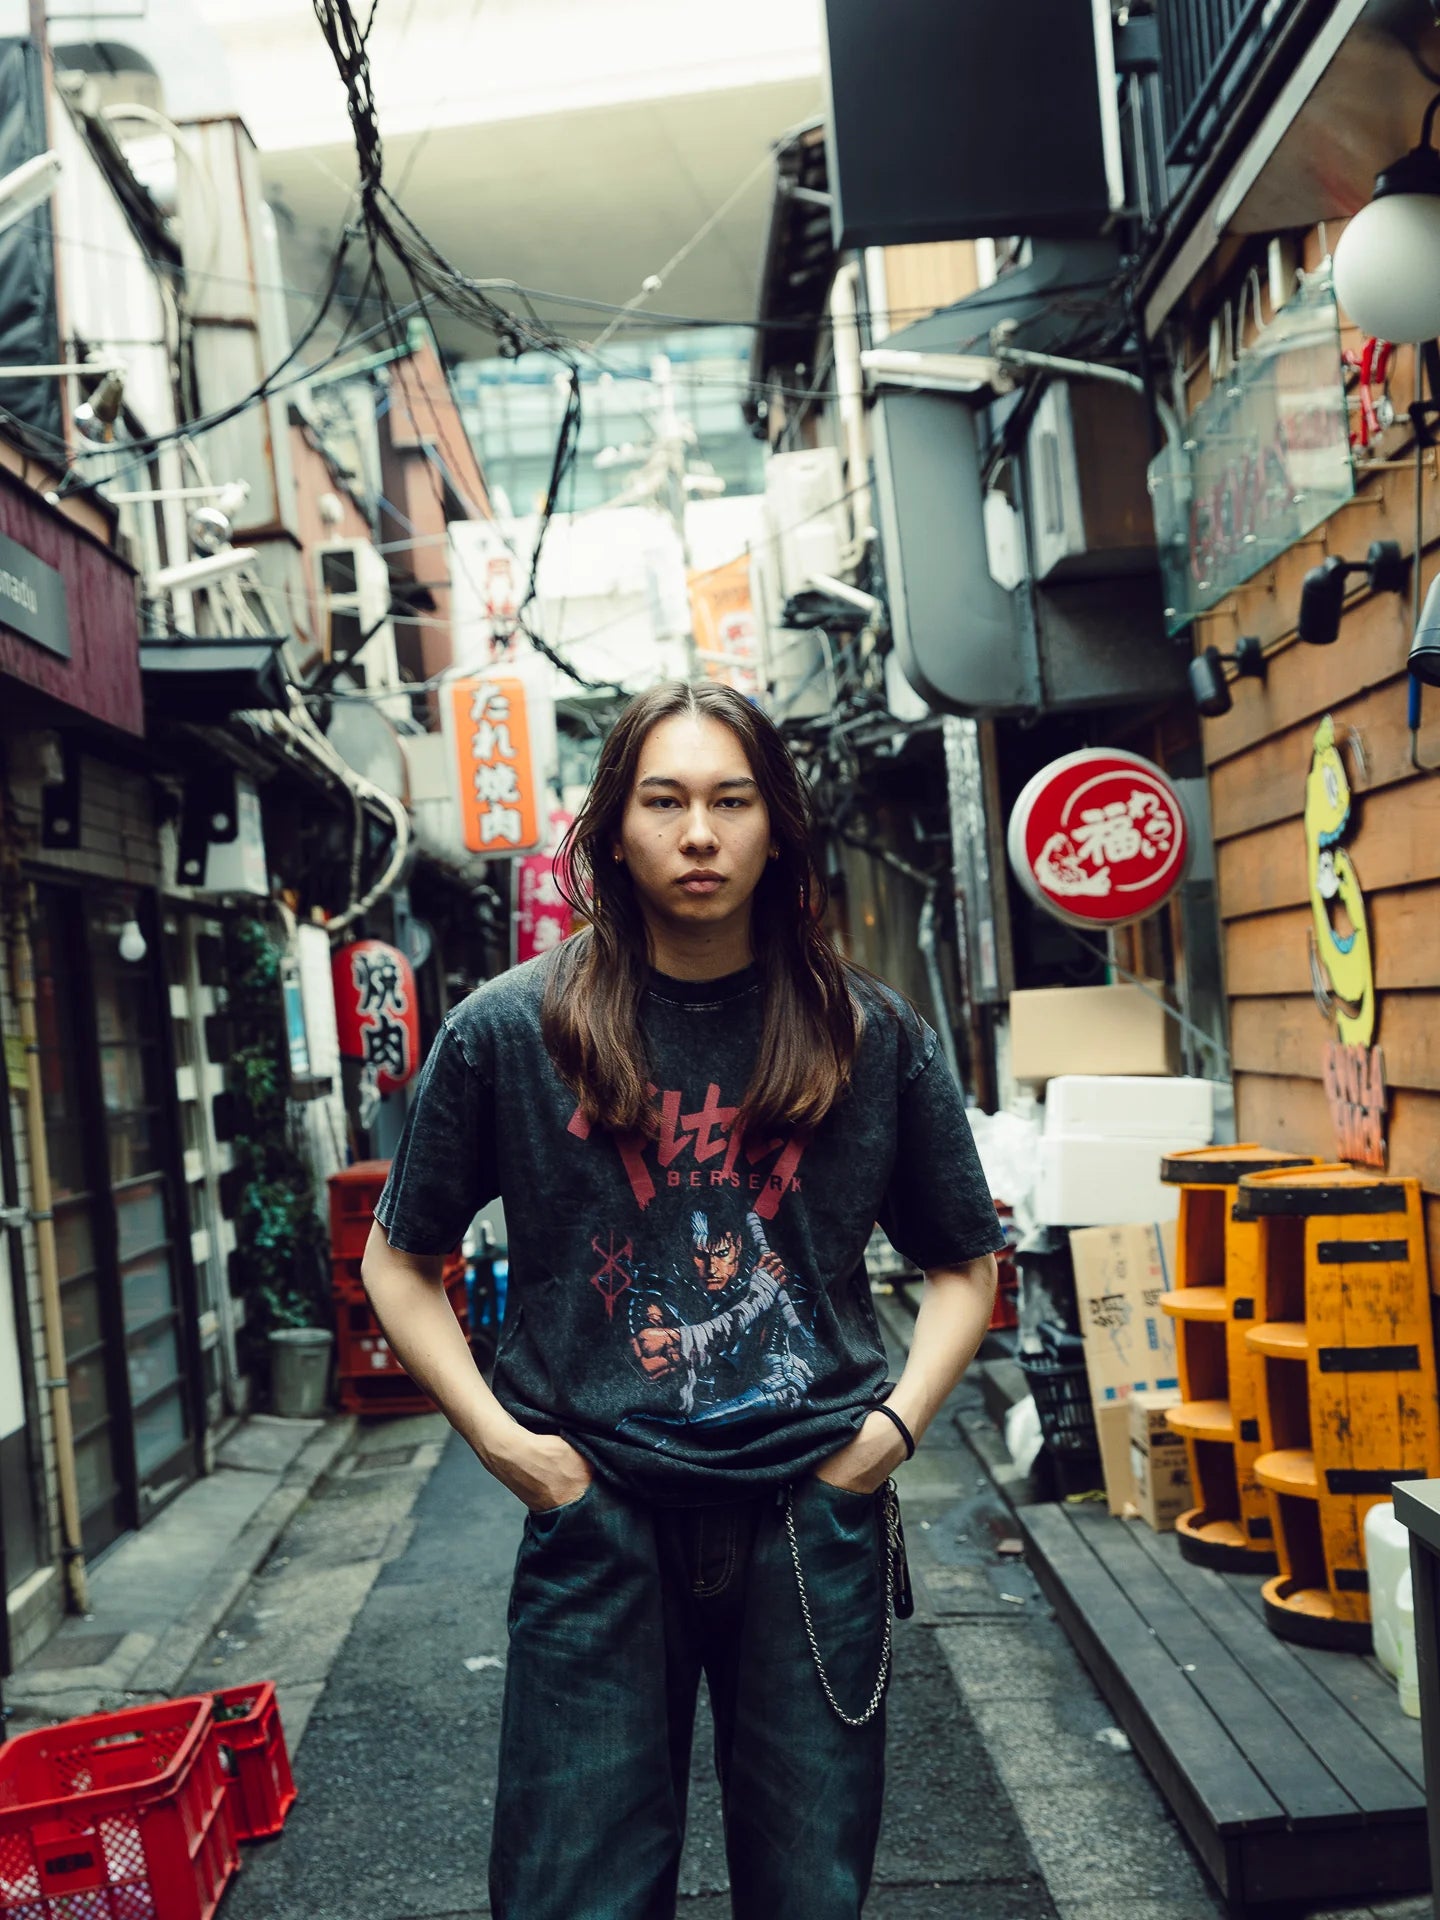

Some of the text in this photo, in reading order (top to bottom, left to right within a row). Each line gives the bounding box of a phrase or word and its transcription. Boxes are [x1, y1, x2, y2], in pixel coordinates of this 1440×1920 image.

[470, 682, 522, 845] たれ焼肉
[353, 952, 408, 1078] 焼肉
[667, 1170, 803, 1193] BERSERK
